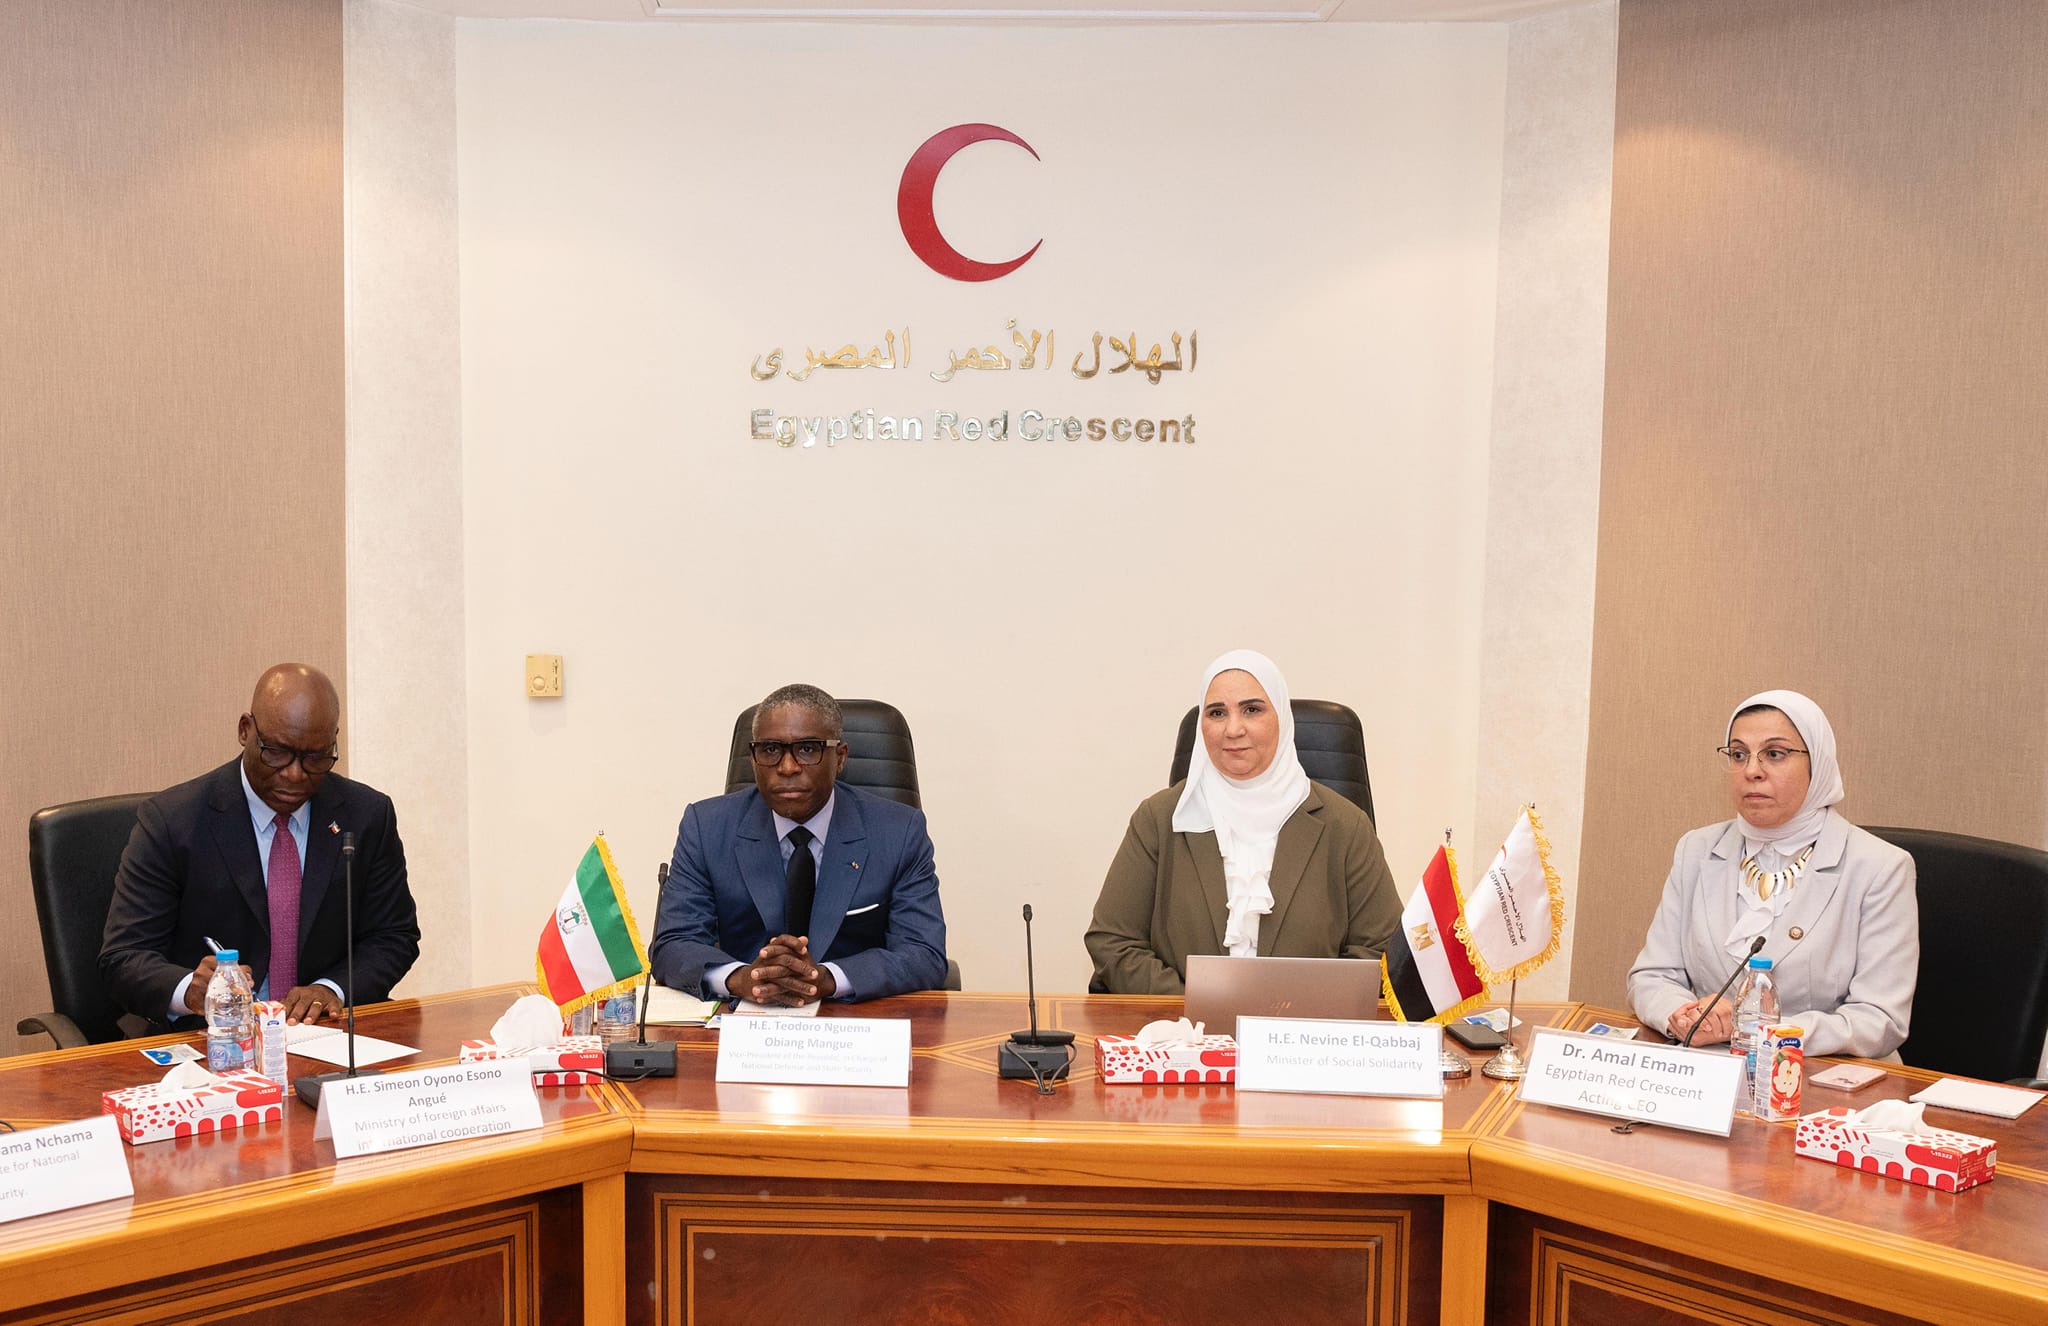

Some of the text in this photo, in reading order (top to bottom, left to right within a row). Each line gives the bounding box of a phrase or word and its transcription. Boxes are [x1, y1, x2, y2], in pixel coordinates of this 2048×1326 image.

[929, 317, 1054, 382] الأحمر
[1072, 329, 1197, 385] الهلال
[751, 408, 1197, 448] Egyptian Red Crescent
[1501, 901, 1509, 915] RED
[1504, 913, 1518, 947] CRESCENT
[749, 1020, 871, 1034] H.E. Teodoro Nguema
[764, 1037, 854, 1050] Obiang Mangue
[1268, 1033, 1421, 1050] H.E. Nevine El-Qabbaj
[1267, 1055, 1423, 1071] Minister of Social Solidarity
[1562, 1043, 1695, 1077] Dr. Amal Emam
[345, 1069, 502, 1096] H.E. Simeon Oyono Esono
[1545, 1063, 1704, 1101] Egyptian Red Crescent
[408, 1092, 447, 1108] Angué
[355, 1103, 507, 1134] Ministry of foreign affairs
[35, 1130, 93, 1149] Nchama
[358, 1120, 512, 1151] innational cooperation
[13, 1160, 29, 1172] for
[33, 1150, 80, 1168] National
